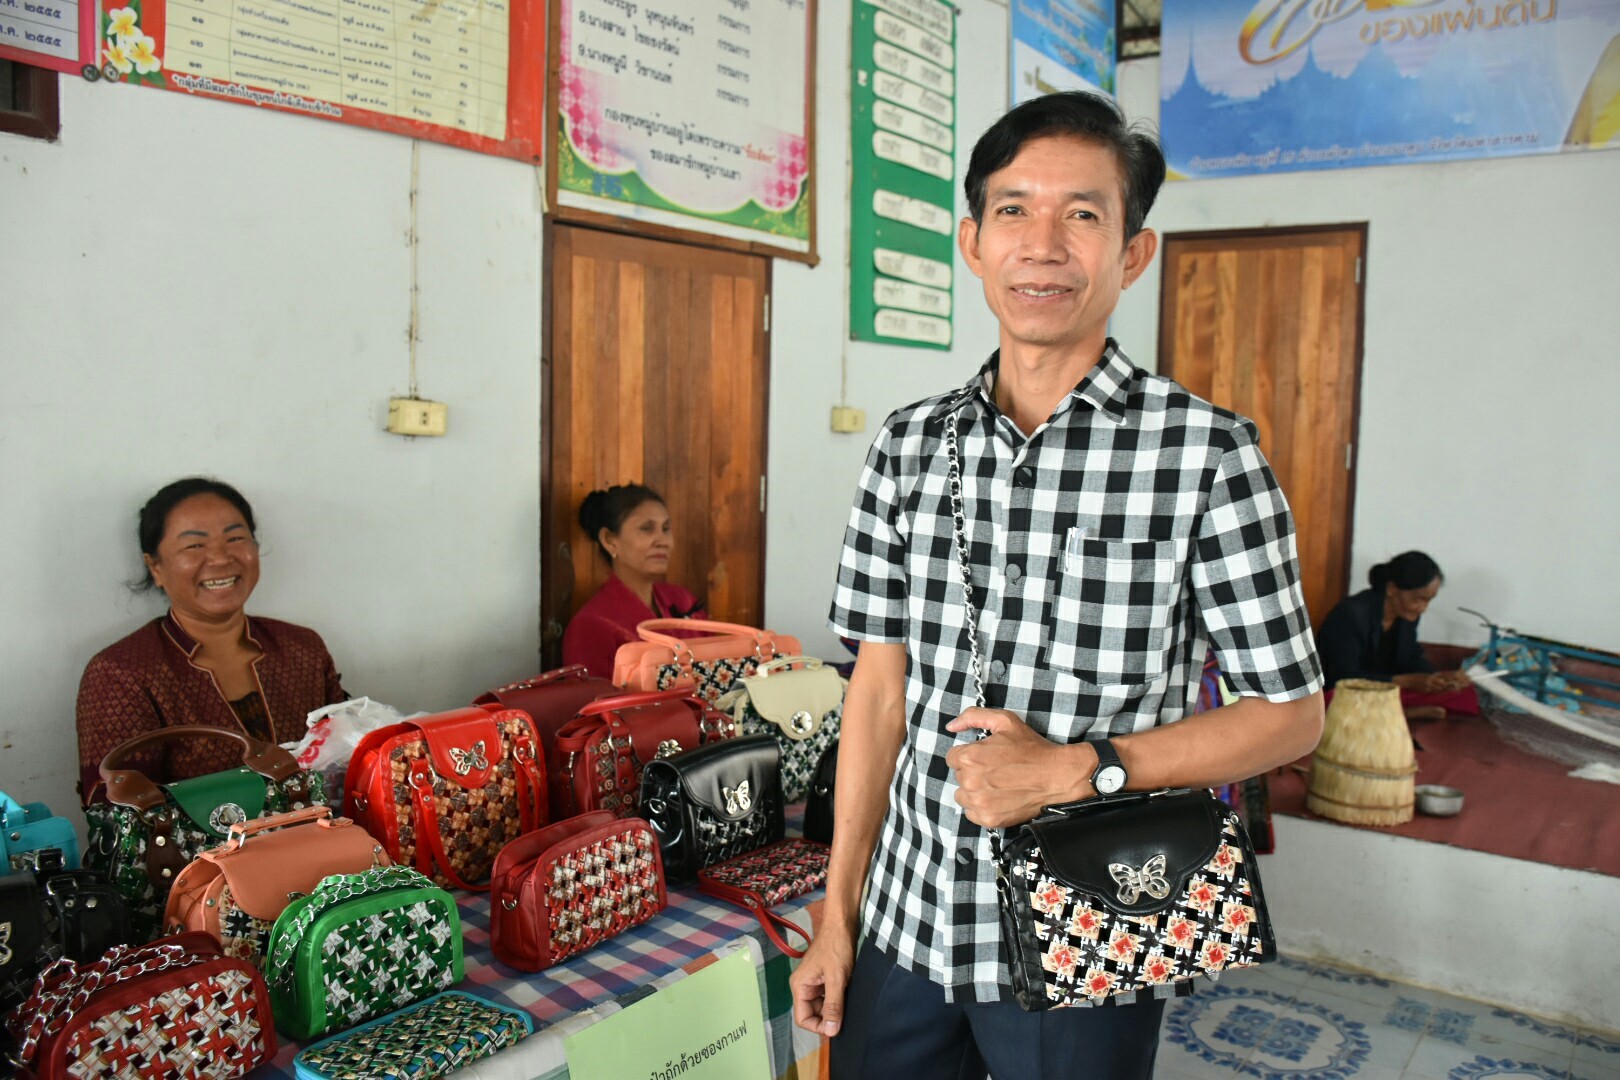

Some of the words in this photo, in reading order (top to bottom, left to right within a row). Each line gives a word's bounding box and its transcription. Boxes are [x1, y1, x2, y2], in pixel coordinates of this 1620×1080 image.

[24, 2, 62, 19] ๒๕๕๕
[1360, 0, 1557, 45] ของแผ่นดน
[25, 30, 62, 47] ๒๕๕๕
